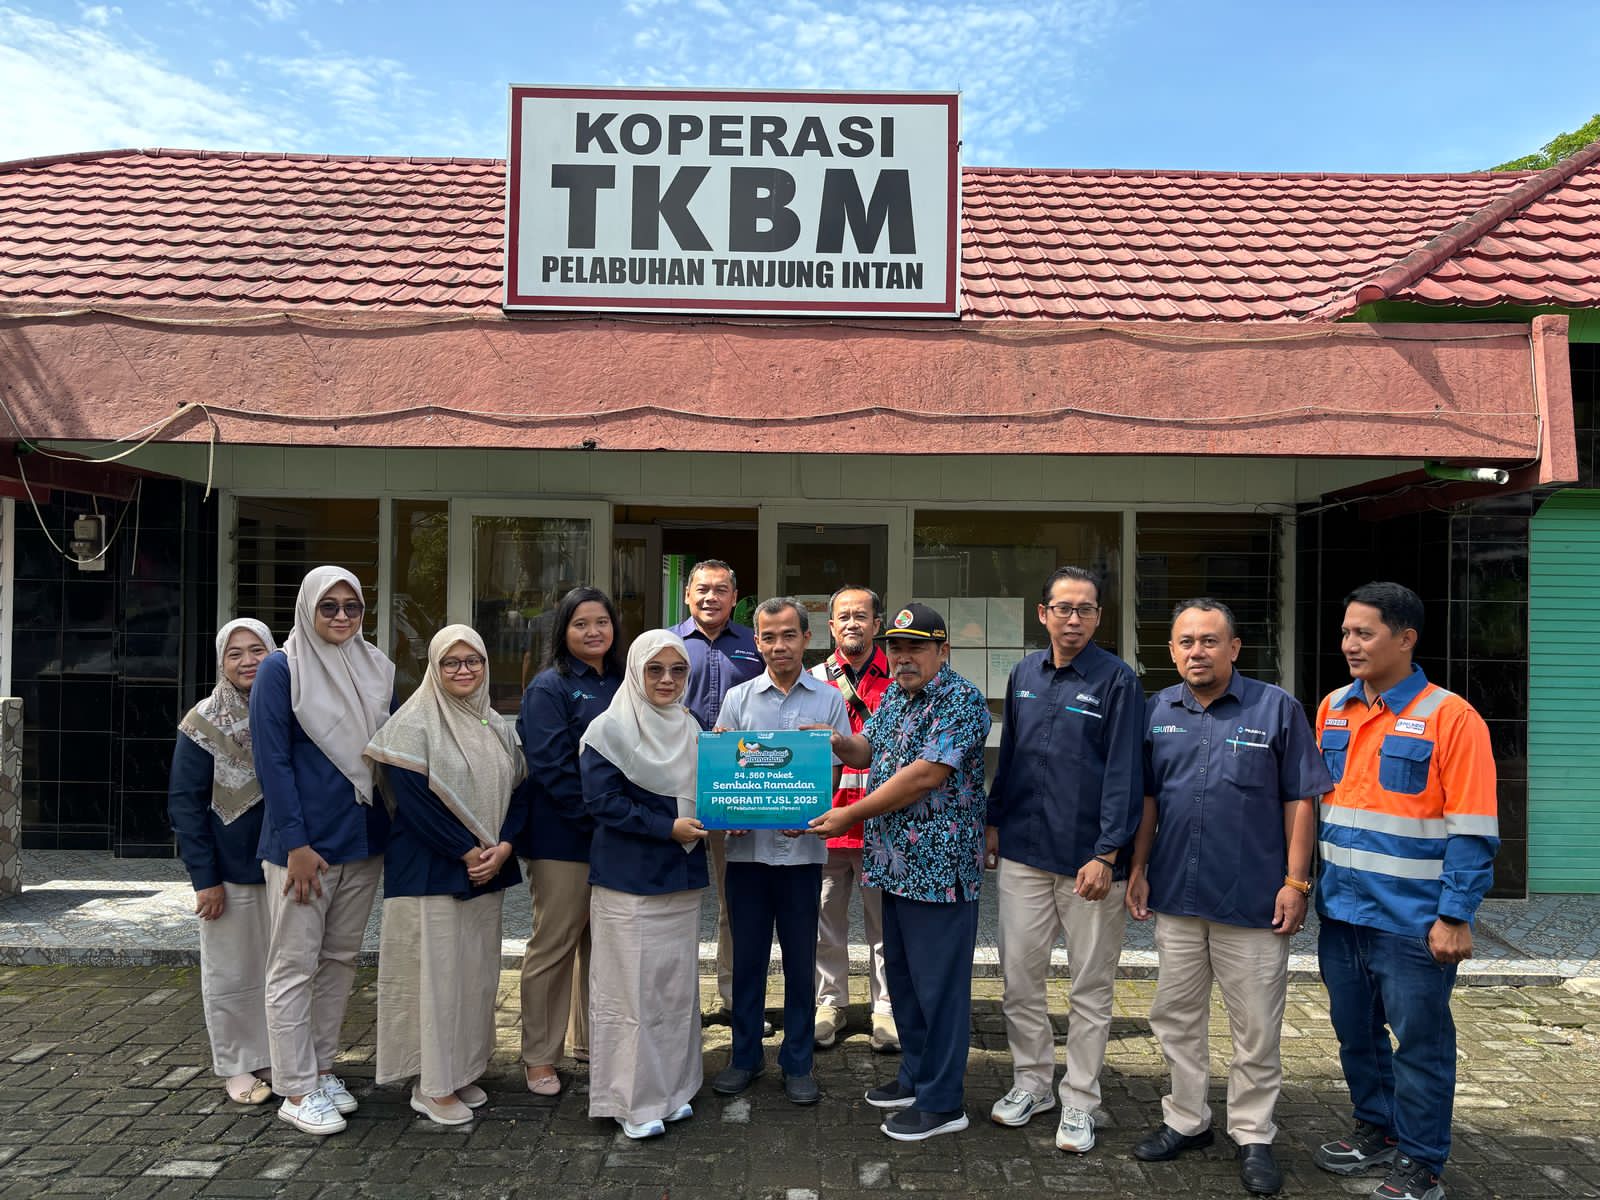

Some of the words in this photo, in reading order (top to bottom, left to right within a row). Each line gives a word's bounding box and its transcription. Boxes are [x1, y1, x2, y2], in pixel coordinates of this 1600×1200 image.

[575, 112, 894, 158] KOPERASI
[551, 164, 917, 254] TKBM
[542, 256, 704, 285] PELABUHAN
[712, 258, 834, 288] TANJUNG
[842, 262, 923, 289] INTAN
[764, 780, 815, 790] Ramadan
[767, 770, 794, 779] Paket
[711, 796, 763, 805] PROGRAM
[766, 796, 791, 805] TJSL
[794, 796, 818, 805] 2025
